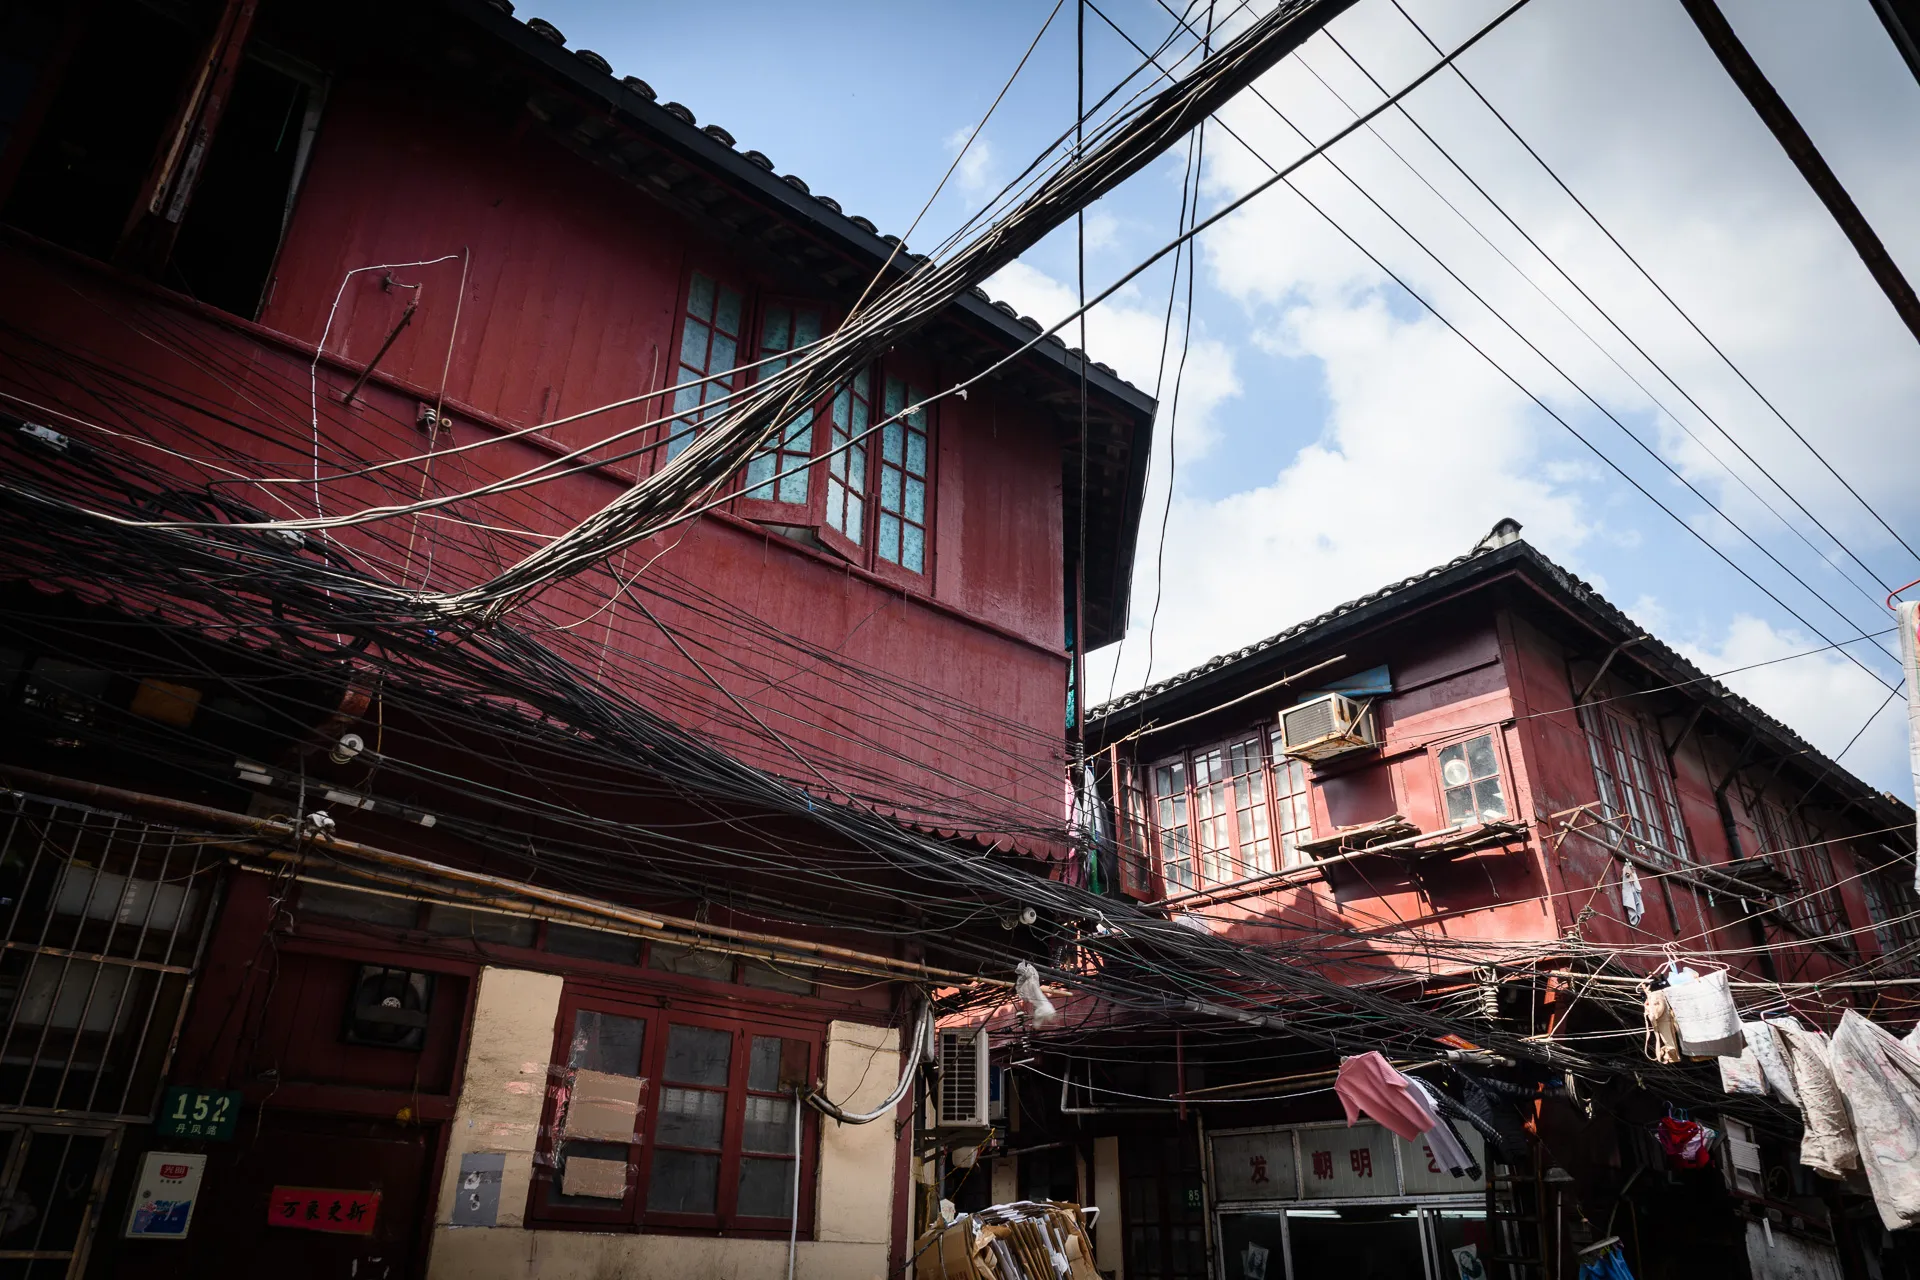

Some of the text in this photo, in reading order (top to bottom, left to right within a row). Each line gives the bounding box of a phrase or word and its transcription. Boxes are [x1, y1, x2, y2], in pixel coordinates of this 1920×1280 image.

[172, 1093, 230, 1122] 152
[175, 1123, 218, 1136] 丹凤路
[1188, 1189, 1200, 1201] 85
